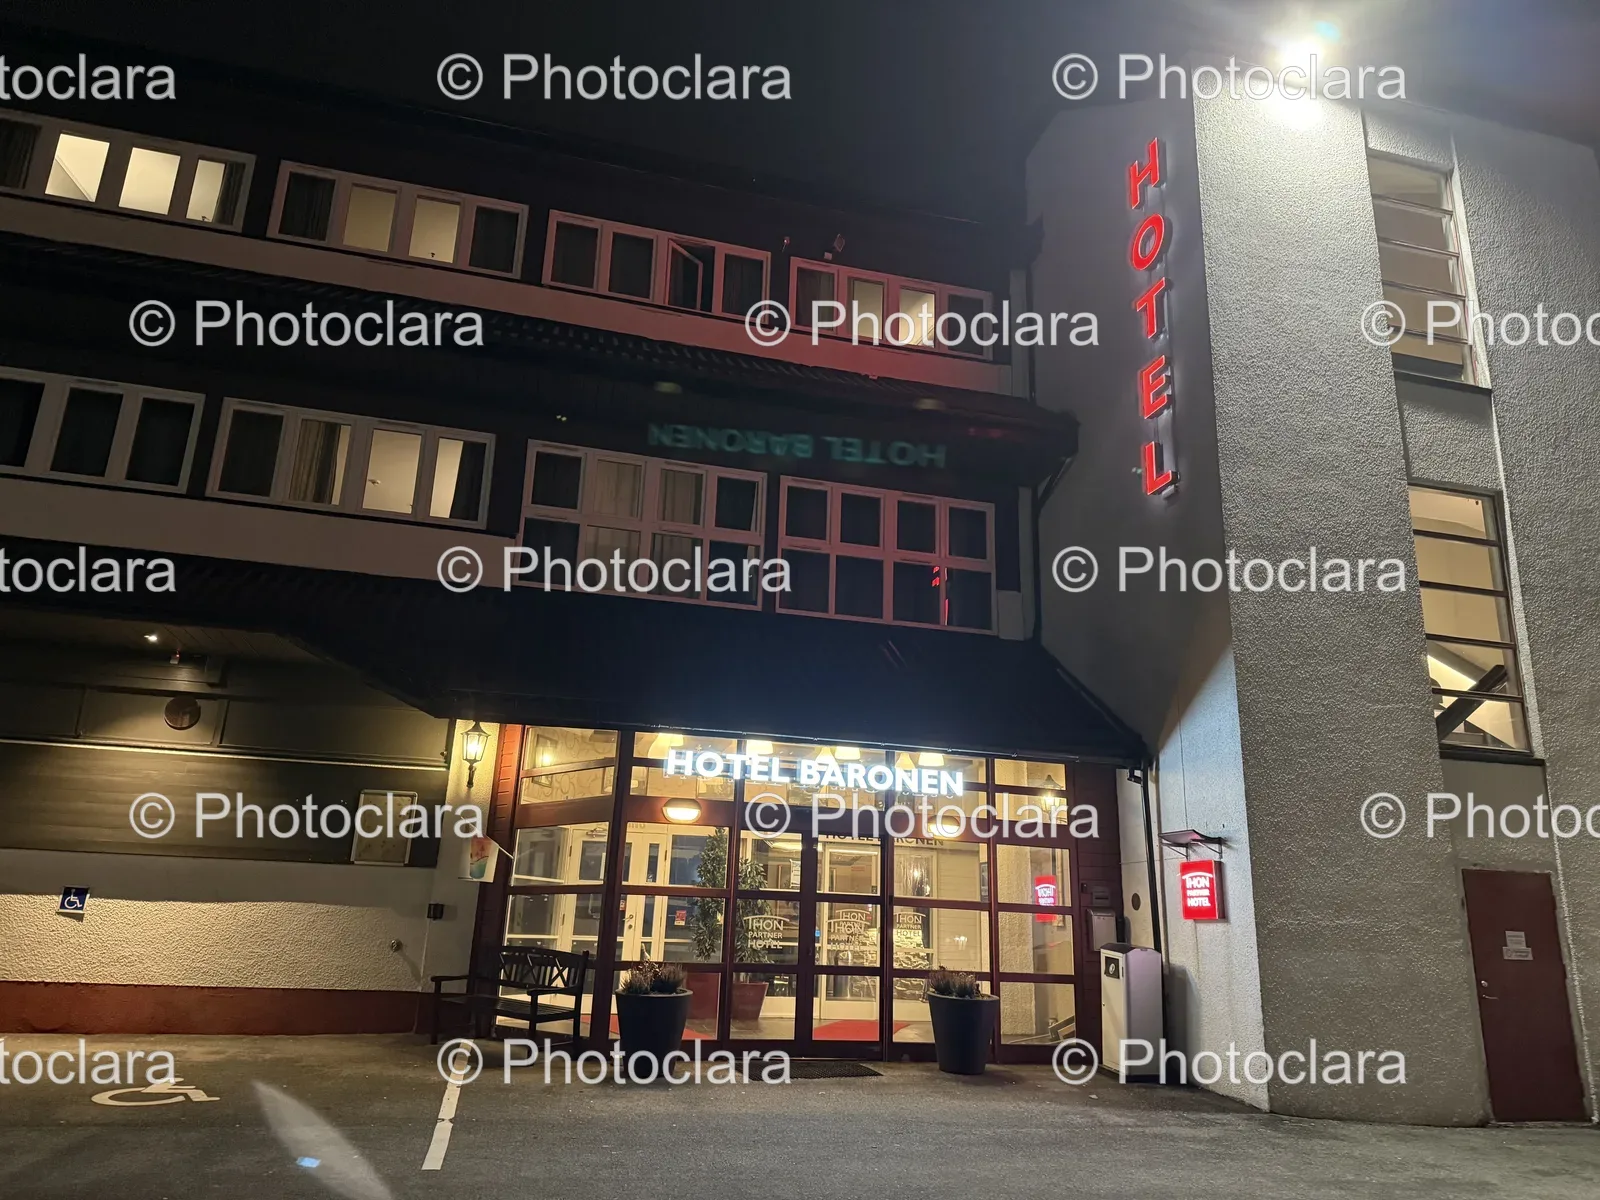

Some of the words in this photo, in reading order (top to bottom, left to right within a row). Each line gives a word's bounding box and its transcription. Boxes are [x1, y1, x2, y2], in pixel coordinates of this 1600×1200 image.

[1126, 137, 1174, 496] HOTEL
[666, 750, 791, 783] HOTEL
[800, 759, 964, 797] BARONEN
[1183, 872, 1213, 889] THON
[744, 915, 789, 931] THON
[895, 912, 926, 924] THON
[748, 931, 783, 939] PARTNER
[748, 940, 783, 949] HOTEL
